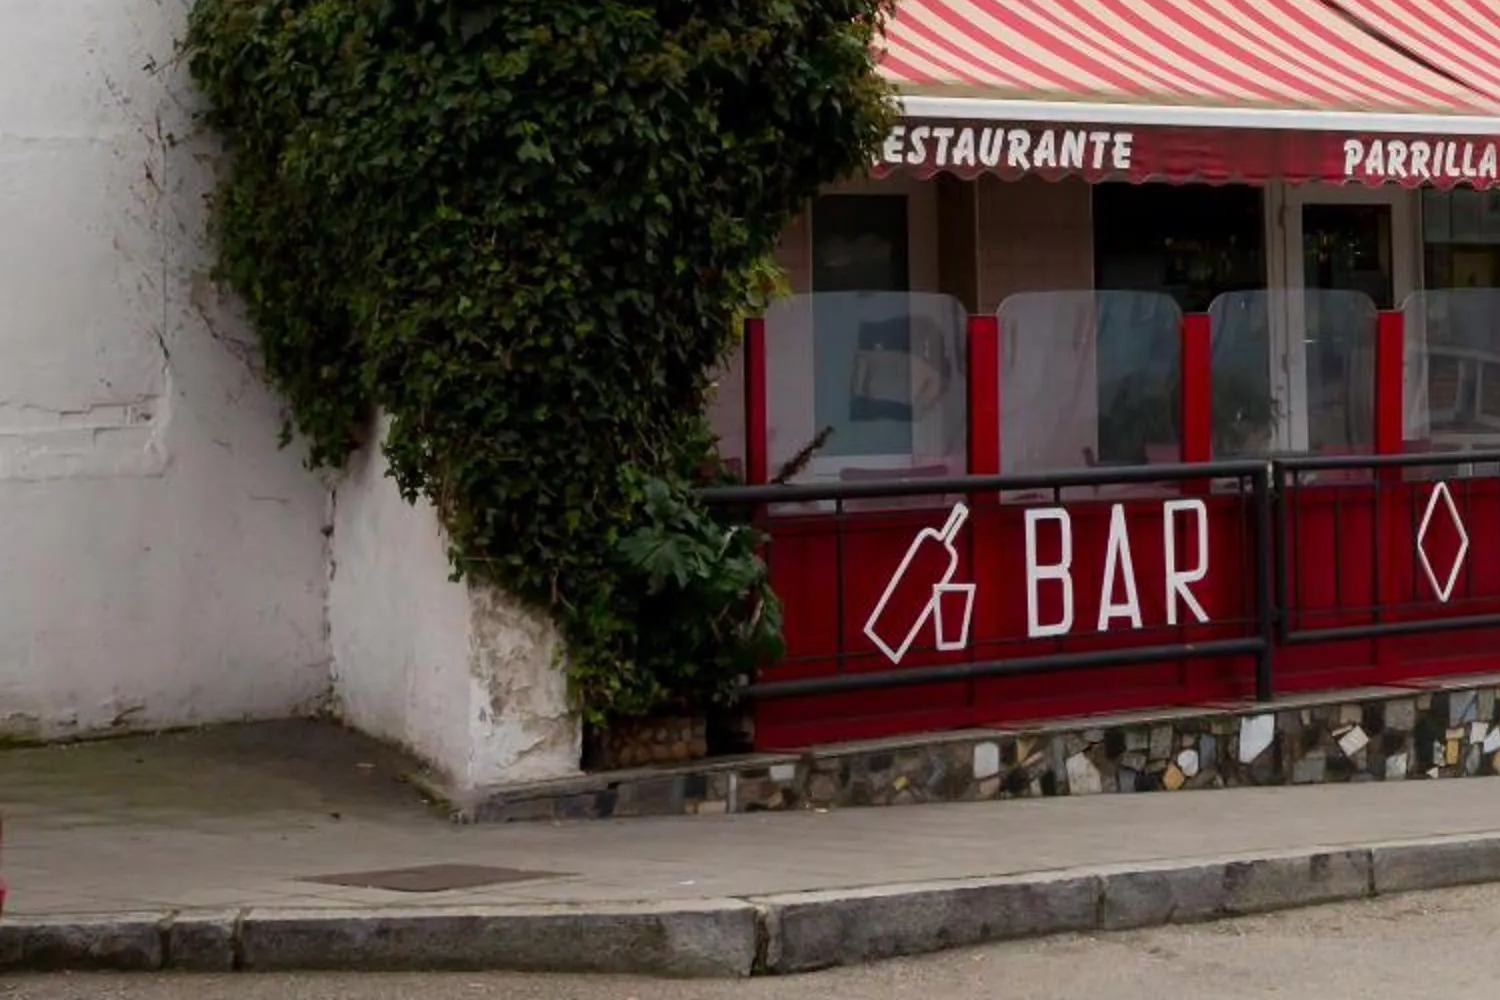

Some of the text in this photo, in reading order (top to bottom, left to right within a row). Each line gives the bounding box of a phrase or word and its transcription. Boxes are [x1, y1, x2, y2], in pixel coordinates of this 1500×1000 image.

[871, 125, 1497, 181] ESTAURANTE PARRILLA
[1024, 498, 1209, 638] BAR
